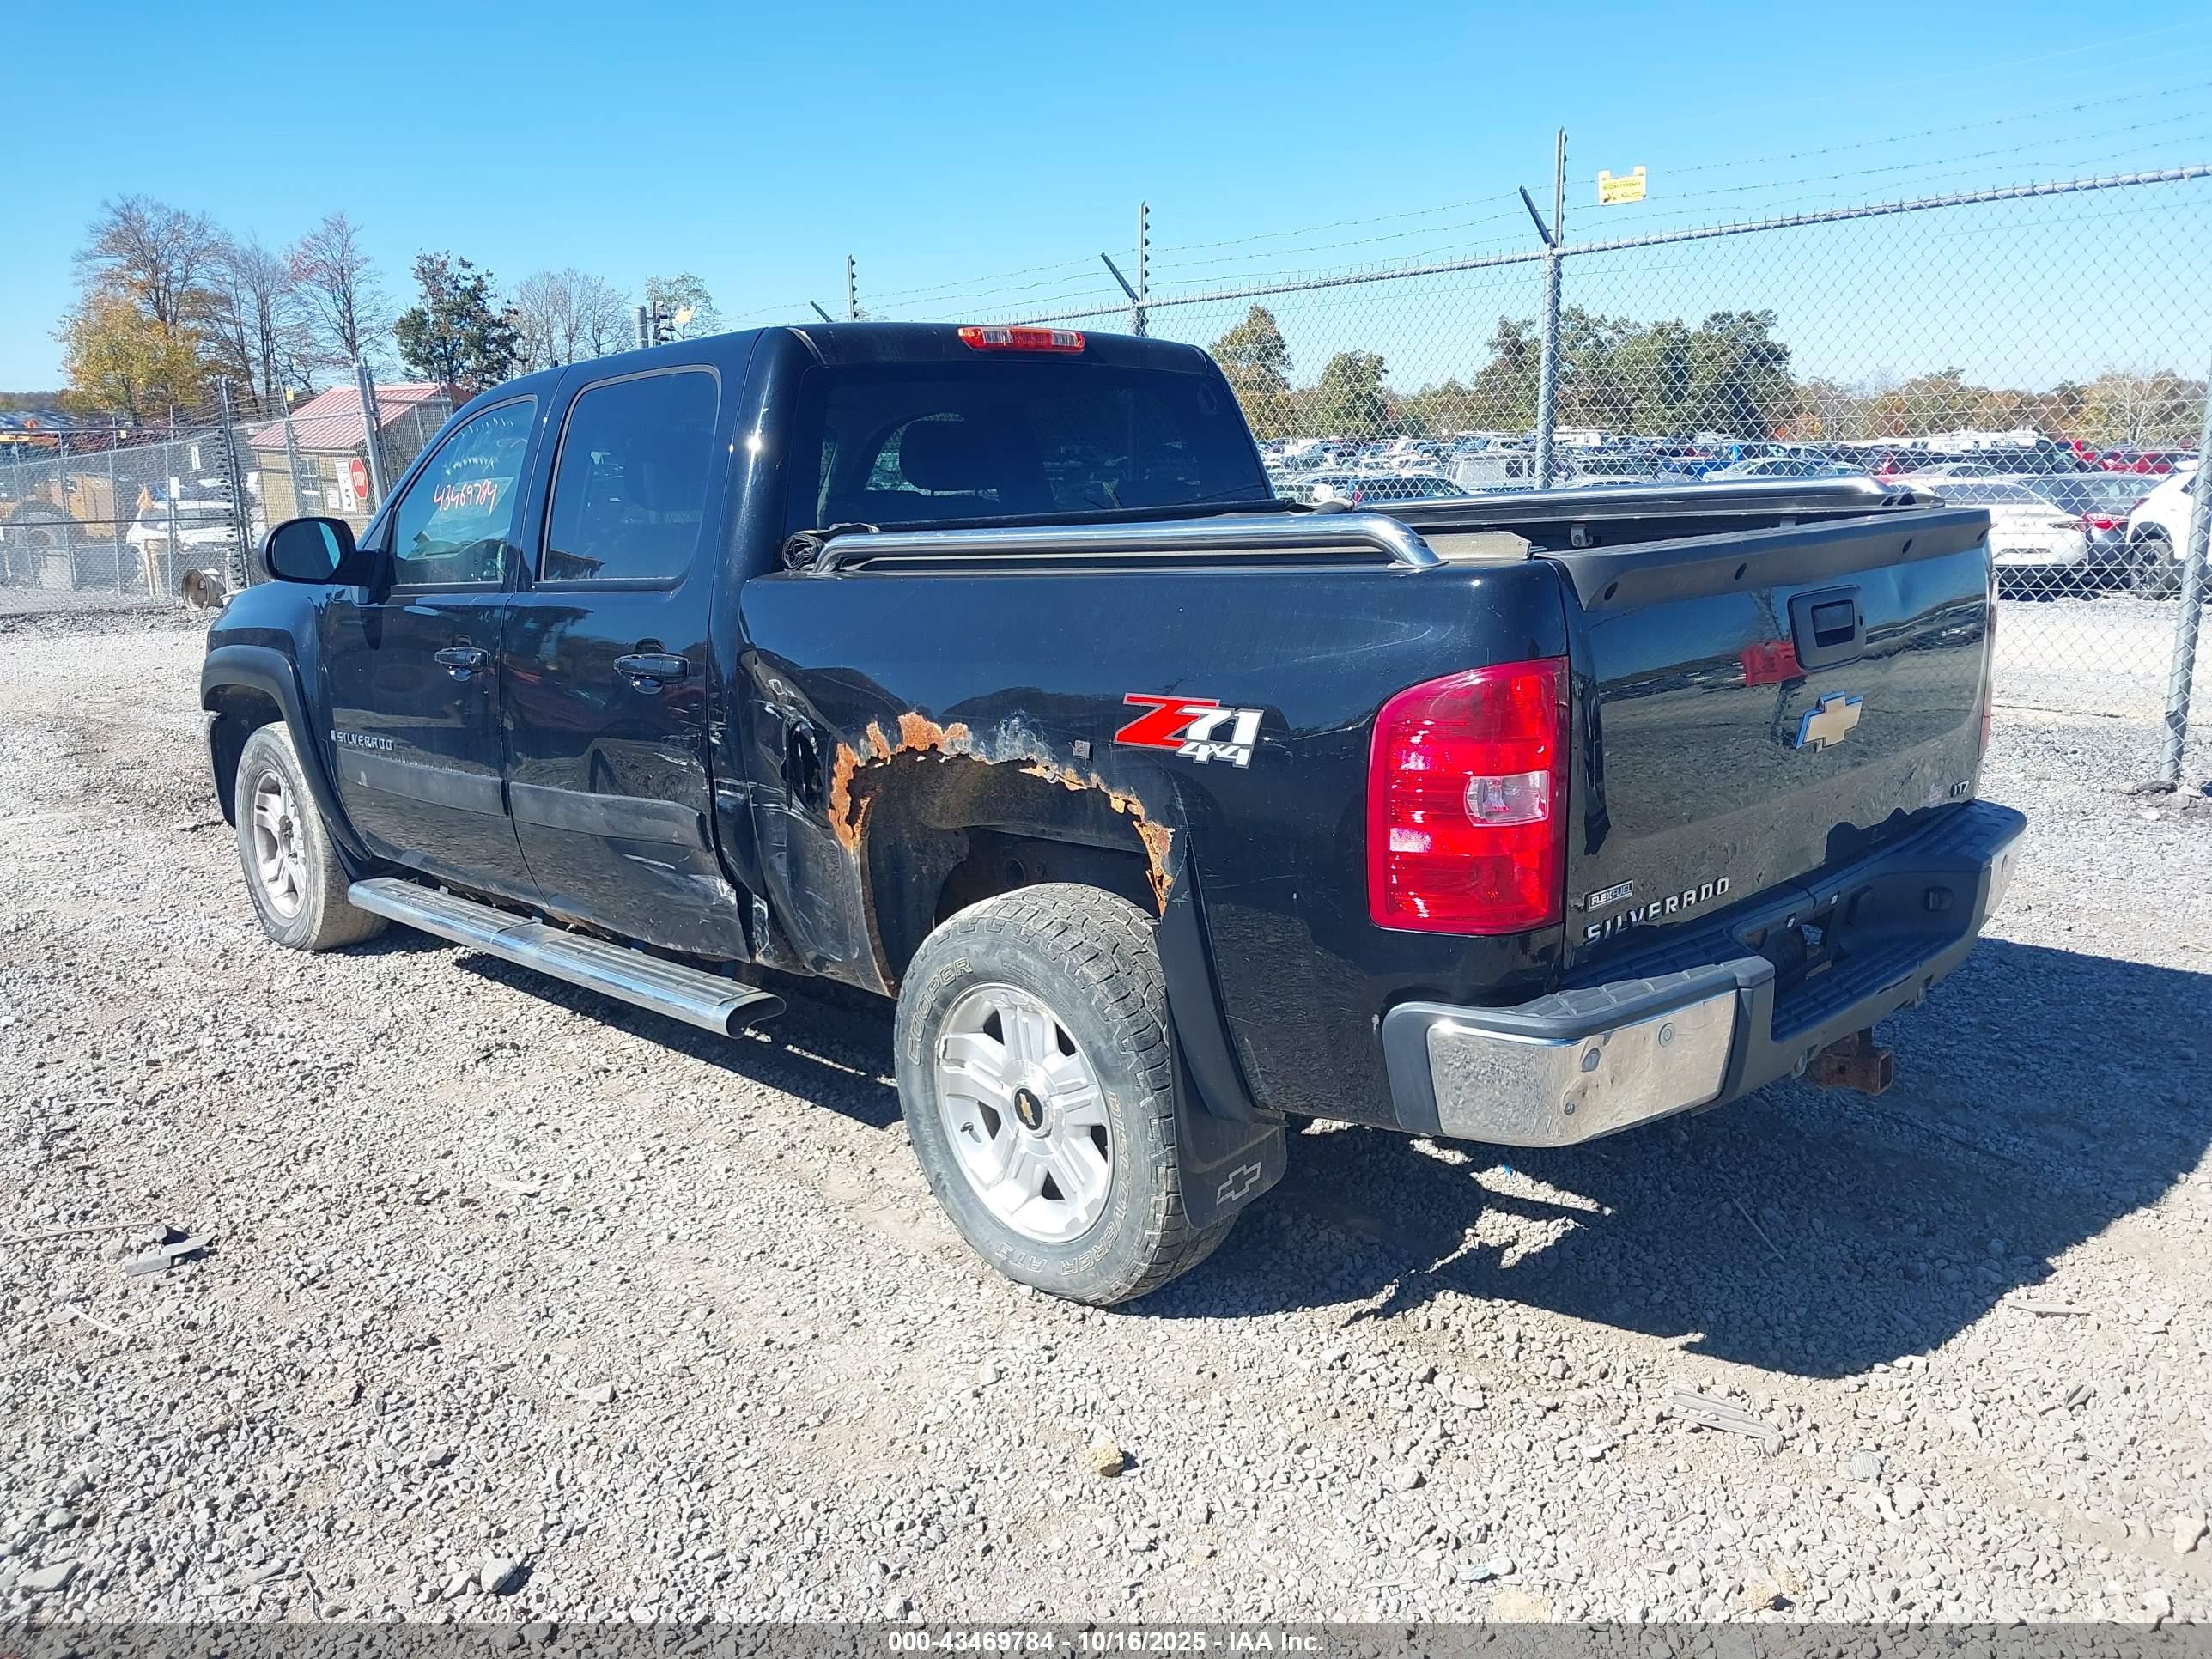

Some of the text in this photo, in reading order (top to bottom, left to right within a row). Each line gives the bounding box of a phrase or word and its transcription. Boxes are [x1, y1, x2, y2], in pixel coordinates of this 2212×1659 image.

[353, 471, 365, 487] STOP
[434, 479, 497, 516] 43469784
[337, 731, 392, 750] SILVERADO
[1114, 693, 1265, 750] Z71
[1583, 876, 1729, 945] SILVERADO
[908, 957, 973, 1065] COOPER
[995, 1091, 1130, 1275] DISCOVERER AT3
